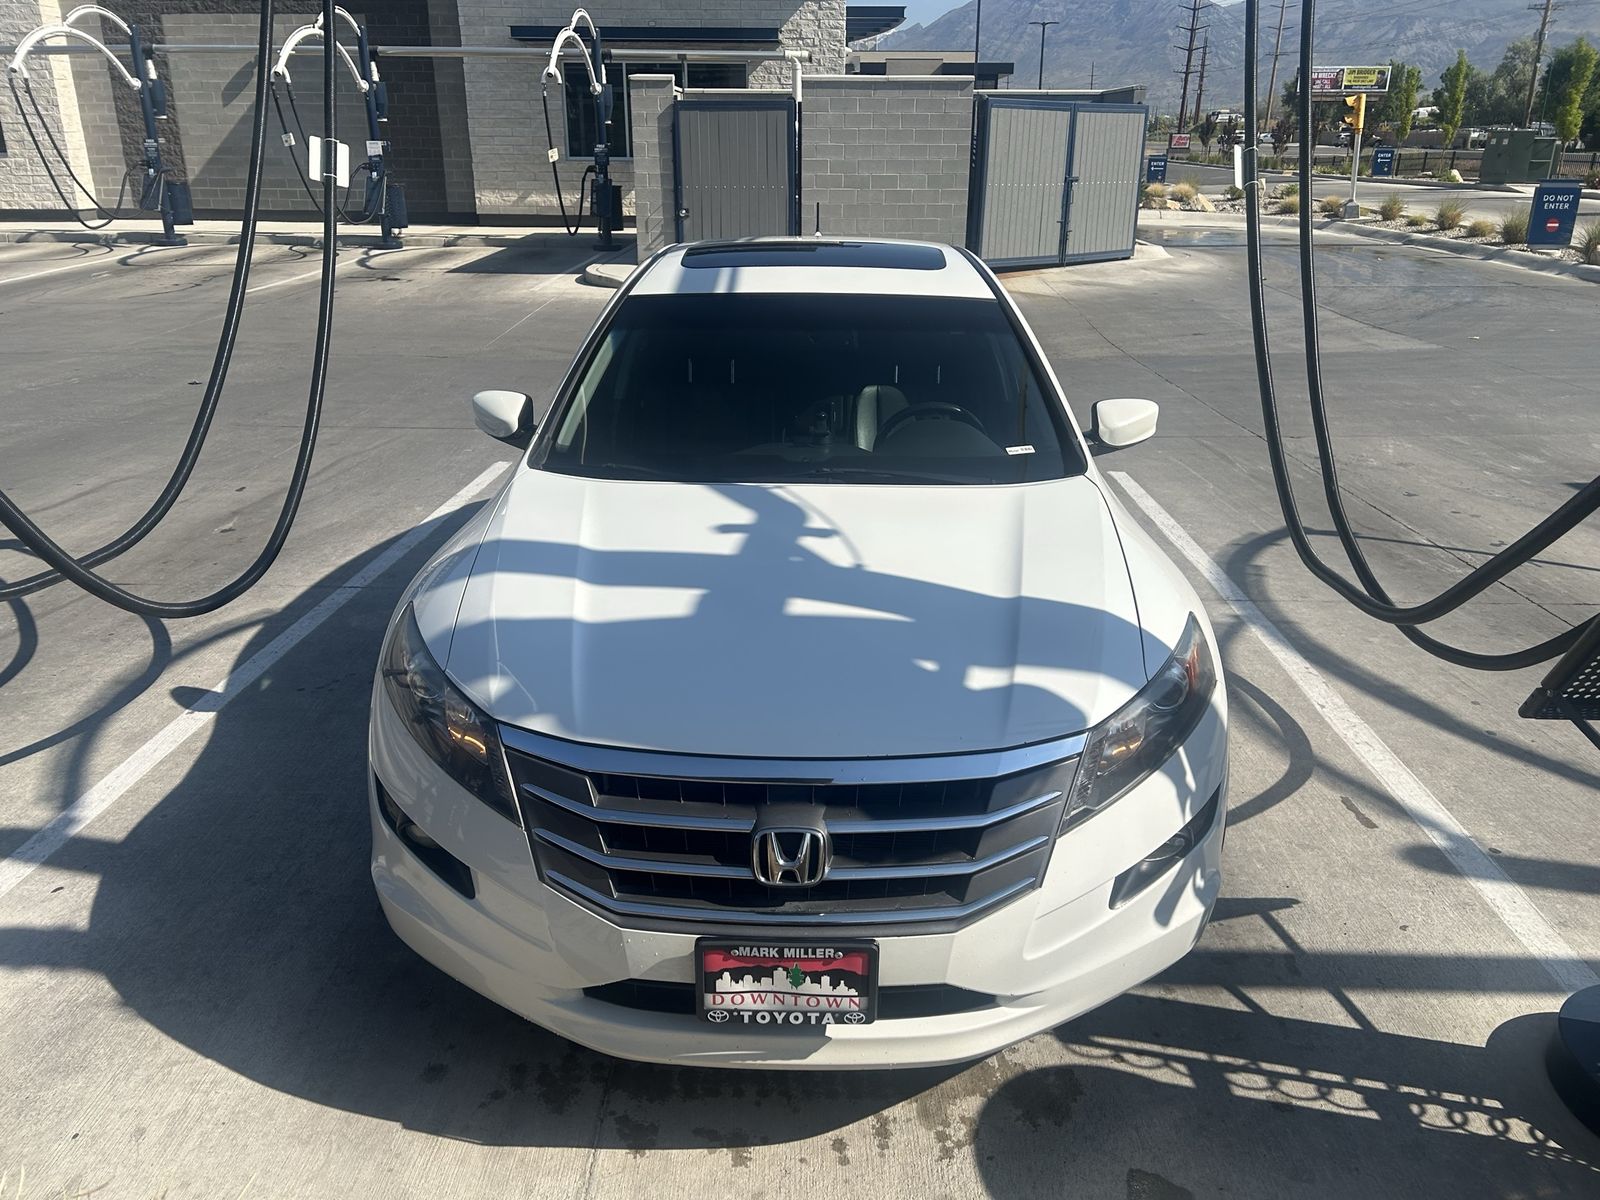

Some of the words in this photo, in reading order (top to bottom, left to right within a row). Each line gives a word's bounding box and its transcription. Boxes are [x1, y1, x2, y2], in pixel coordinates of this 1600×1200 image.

[1543, 194, 1556, 202] DO
[1556, 194, 1574, 202] NOT
[1544, 202, 1570, 210] ENTER
[738, 946, 780, 958] MARK
[783, 947, 835, 959] MILLER
[711, 992, 861, 1009] DOWNTOWN
[740, 1011, 835, 1025] TOYOTA
